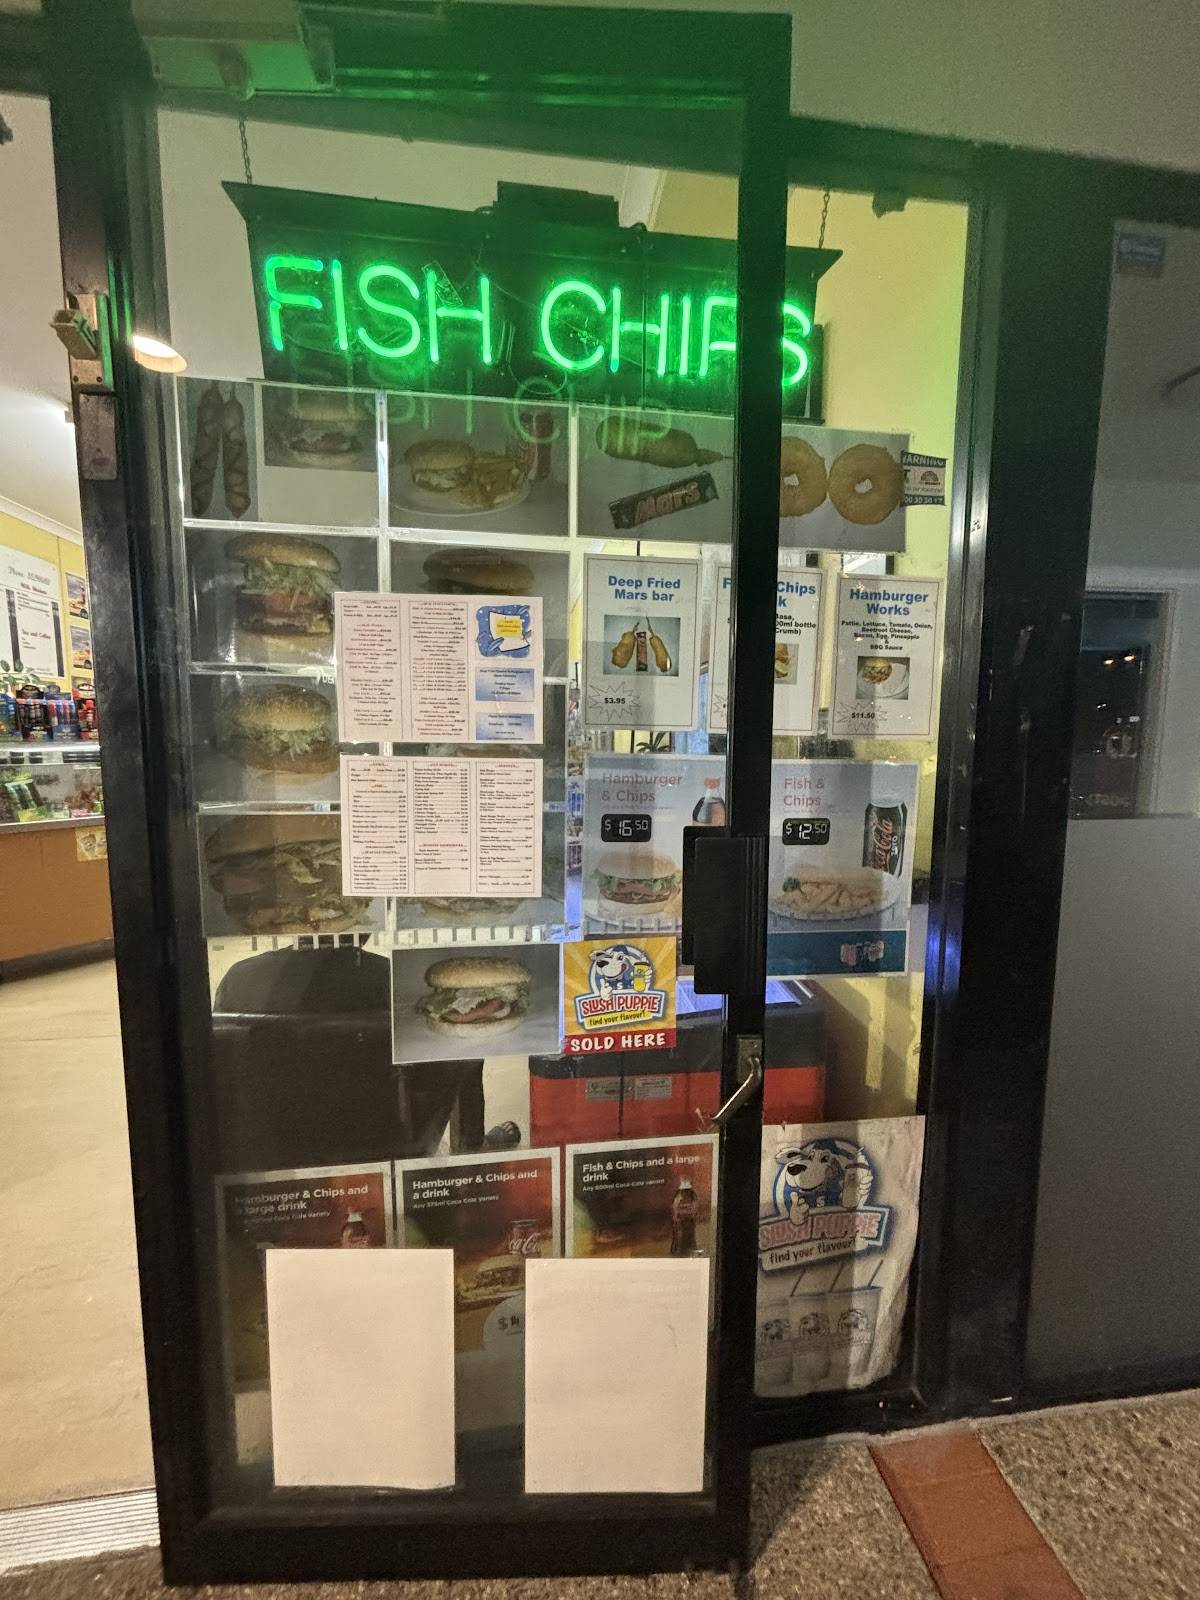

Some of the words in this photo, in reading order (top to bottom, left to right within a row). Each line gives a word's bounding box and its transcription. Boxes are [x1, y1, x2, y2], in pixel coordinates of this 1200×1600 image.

[263, 255, 492, 365] FISH
[608, 576, 642, 588] Deep
[647, 578, 680, 588] Fried
[776, 581, 816, 596] Chips
[614, 589, 648, 600] Mars
[652, 590, 674, 601] bar
[850, 588, 928, 604] Hamburger
[866, 604, 910, 616] Works
[602, 772, 683, 787] Hamburger
[784, 776, 811, 790] Fish
[816, 778, 824, 789] &
[602, 790, 610, 801] &
[616, 790, 656, 804] Chips
[784, 794, 821, 810] Chips
[589, 1016, 602, 1026] find
[604, 1016, 618, 1025] your
[570, 1036, 614, 1052] SOLD
[622, 1032, 666, 1048] HERE
[582, 1162, 604, 1174] Fish
[606, 1161, 613, 1170] &
[616, 1159, 644, 1170] Chips
[646, 1156, 665, 1166] and
[675, 1154, 700, 1165] large
[412, 1176, 473, 1190] Hamburger
[476, 1174, 483, 1184] &
[486, 1170, 515, 1182] Chips
[517, 1169, 538, 1180] and
[582, 1172, 608, 1182] drink
[302, 1190, 310, 1198] &
[314, 1188, 345, 1200] Chips
[348, 1185, 368, 1195] and
[412, 1192, 420, 1200] a
[422, 1188, 450, 1199] drink
[278, 1201, 307, 1212] drink
[770, 1250, 790, 1264] find
[790, 1248, 813, 1262] your
